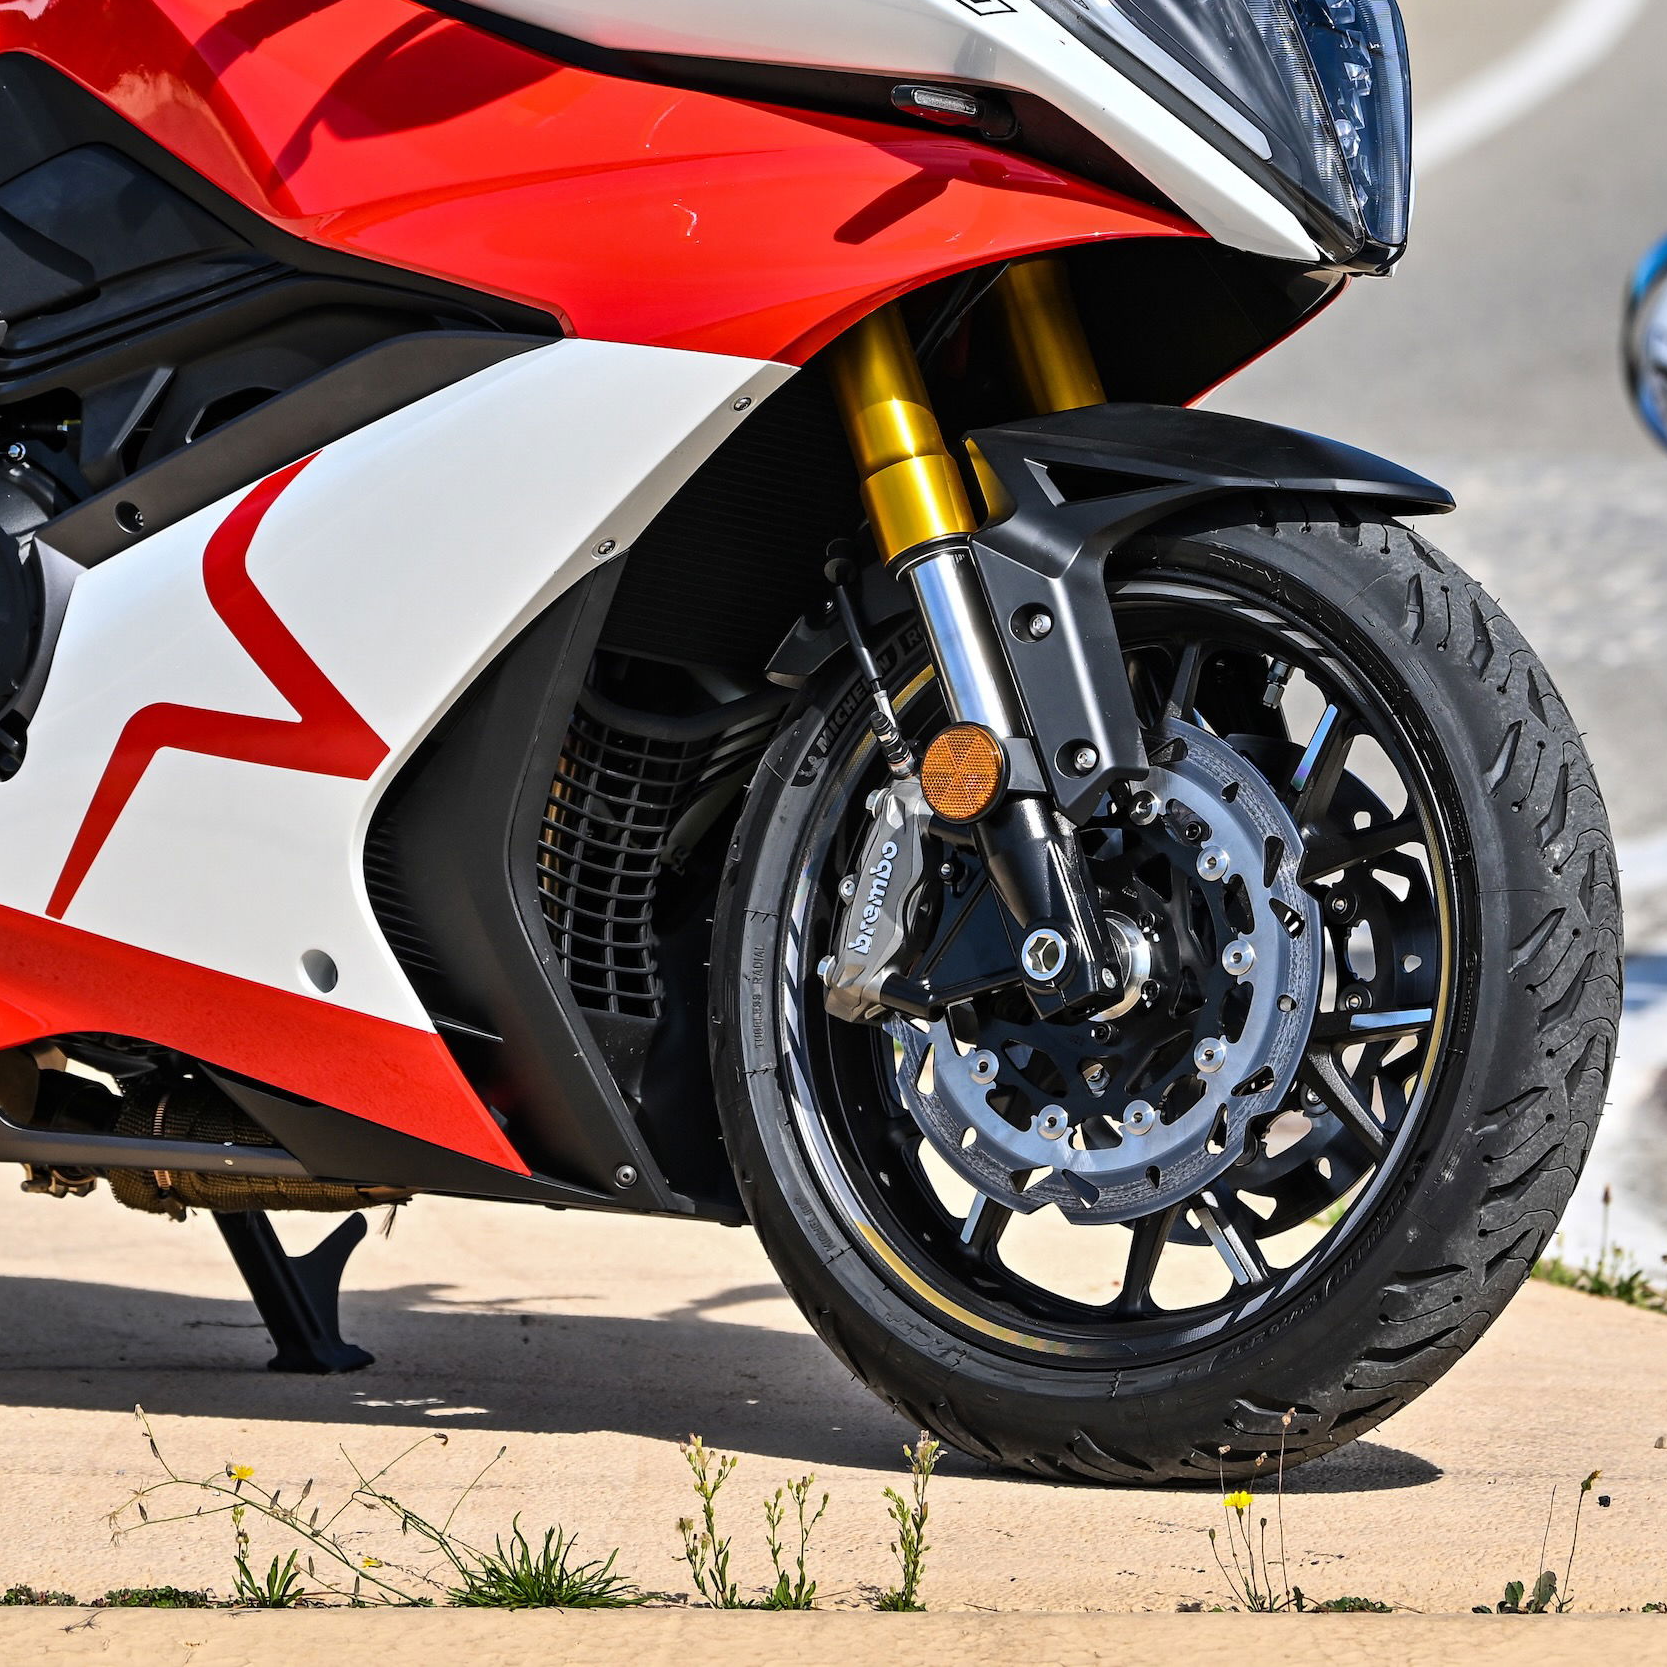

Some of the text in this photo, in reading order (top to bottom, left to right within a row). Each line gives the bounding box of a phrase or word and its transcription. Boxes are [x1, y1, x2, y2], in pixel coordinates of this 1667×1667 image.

[817, 650, 894, 754] MICHEN
[847, 841, 898, 955] brembo
[751, 945, 765, 985] RADIAL
